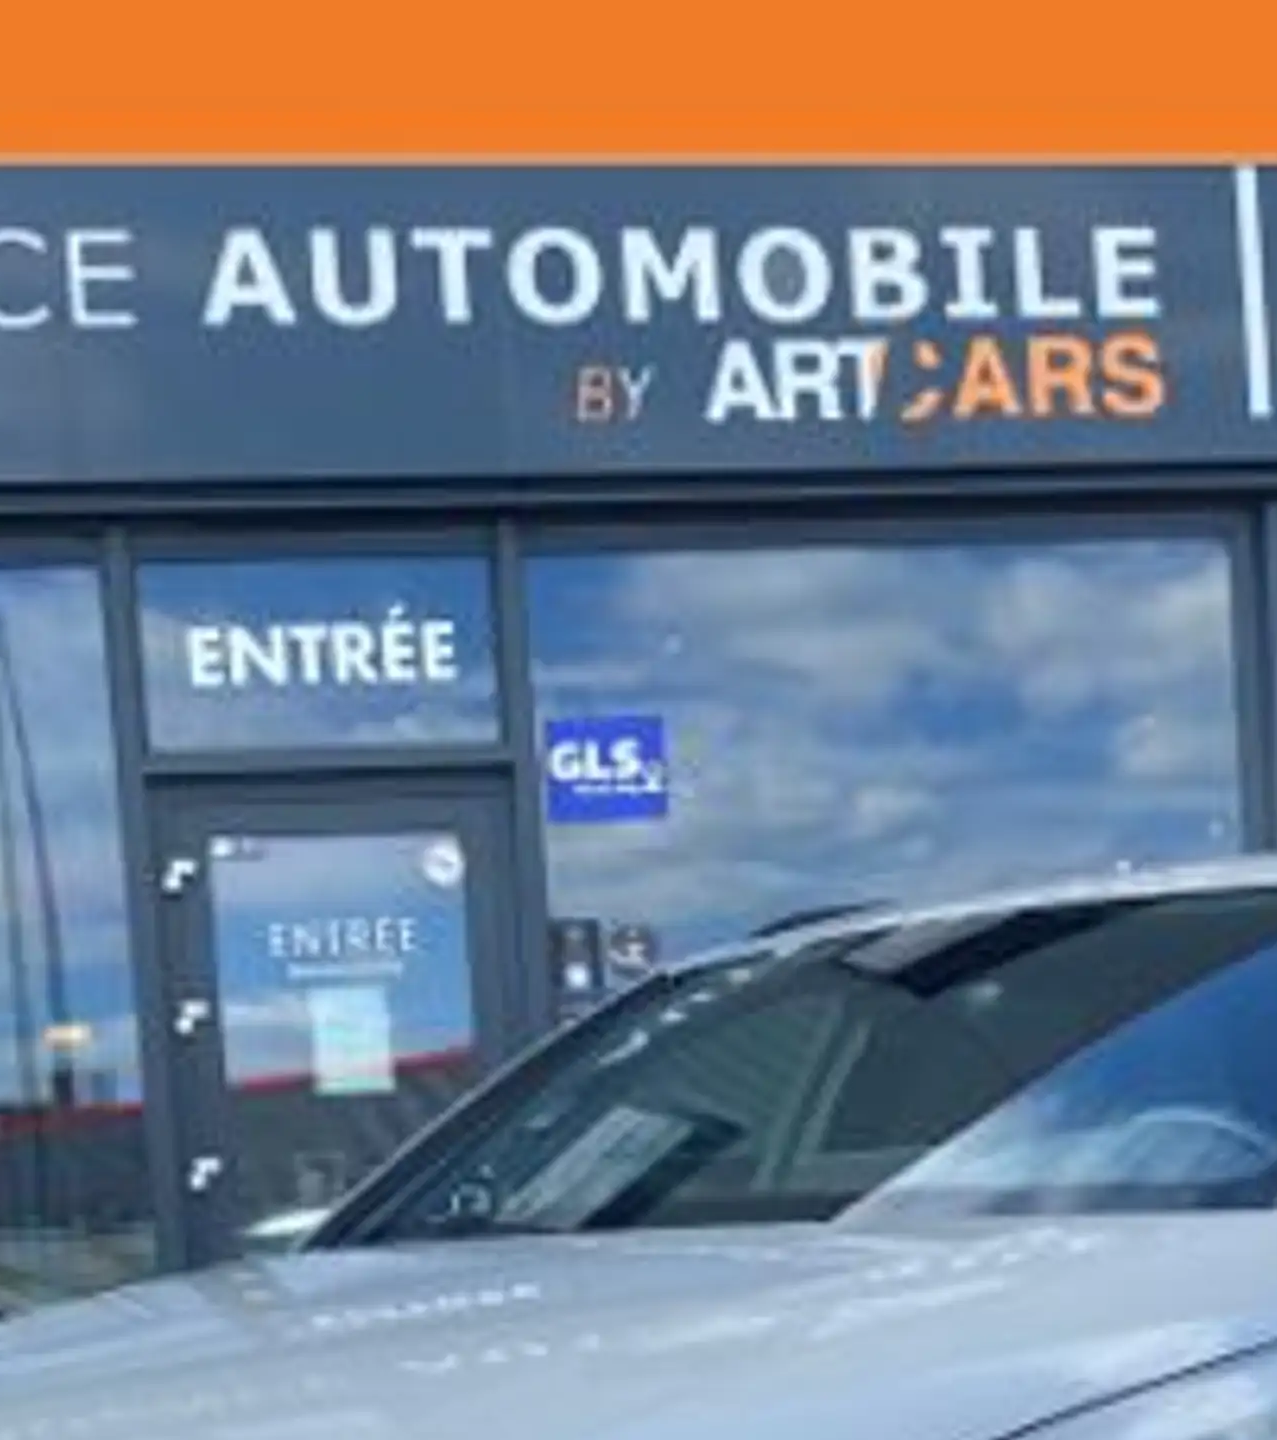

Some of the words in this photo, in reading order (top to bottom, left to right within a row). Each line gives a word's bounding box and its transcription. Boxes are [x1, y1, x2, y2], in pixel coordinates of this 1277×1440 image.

[202, 225, 1164, 327] AUTOMOBILE
[575, 364, 652, 424] BY
[185, 598, 459, 688] ENTRÉE
[549, 738, 642, 782] GLS
